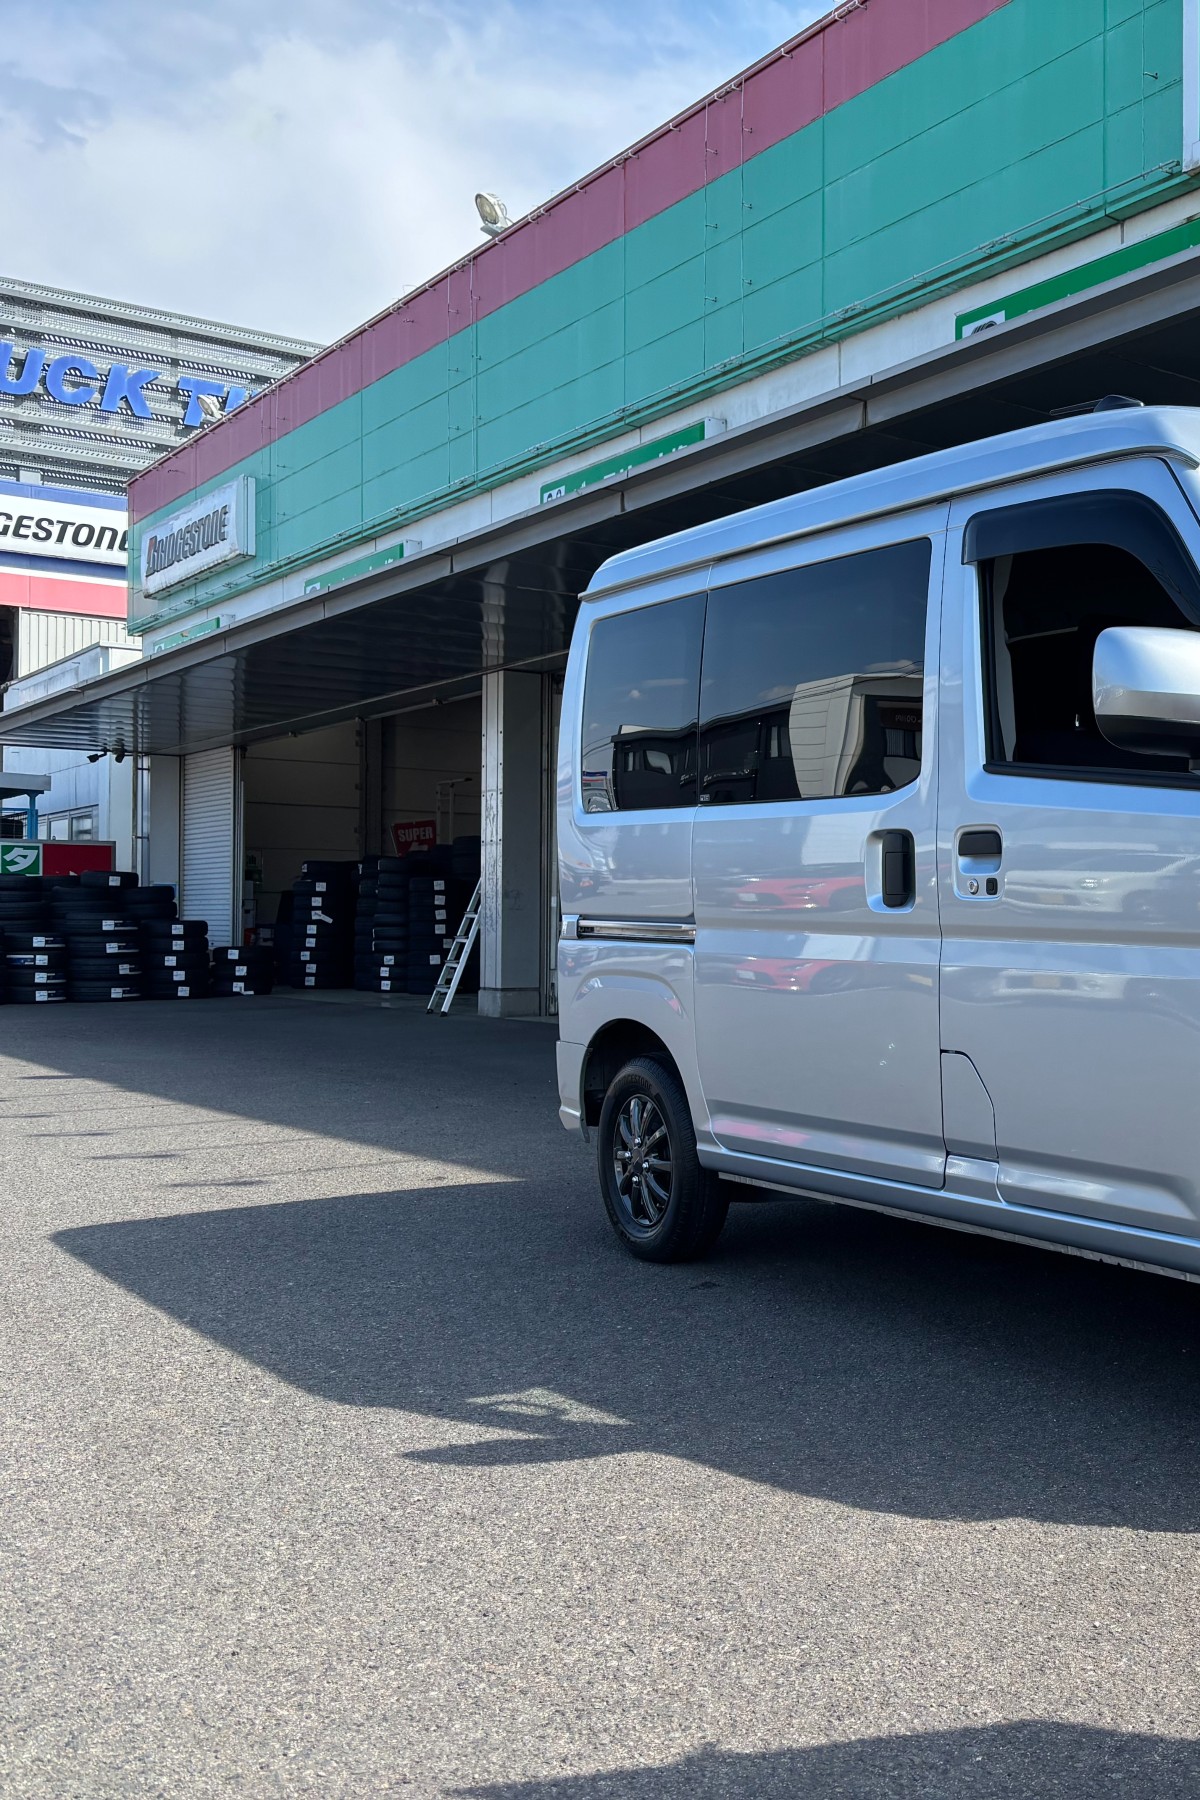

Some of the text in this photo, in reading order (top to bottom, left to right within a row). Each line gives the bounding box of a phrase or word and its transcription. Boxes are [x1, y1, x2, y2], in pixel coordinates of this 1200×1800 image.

[146, 505, 229, 578] BRIDGESTONE
[398, 826, 433, 842] SUPER
[3, 847, 39, 873] タ
